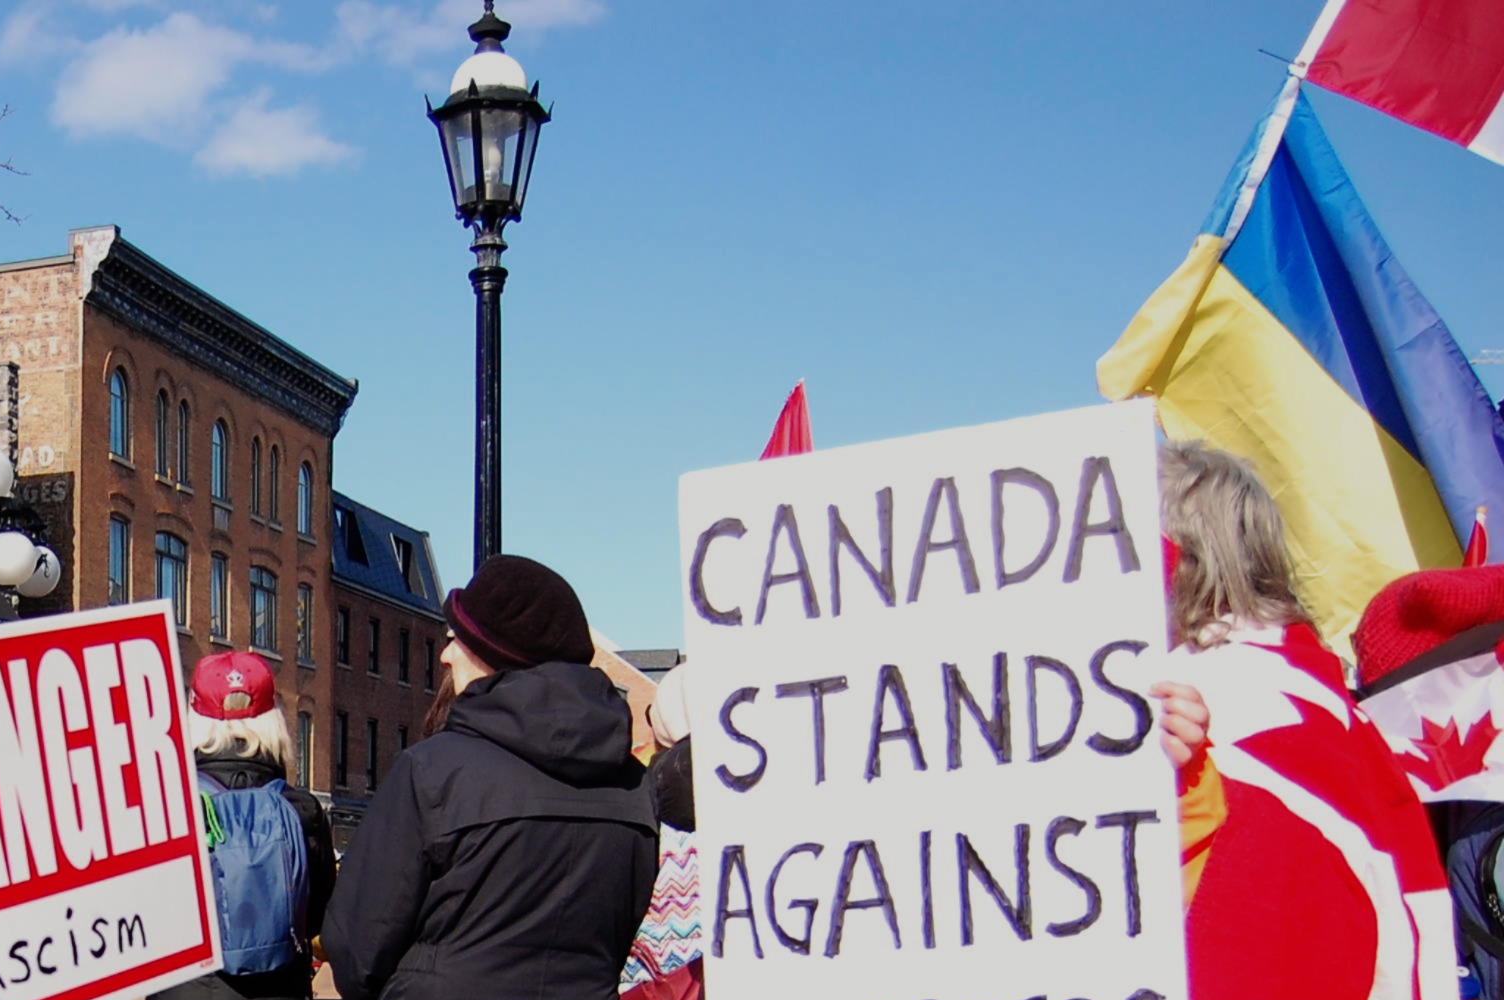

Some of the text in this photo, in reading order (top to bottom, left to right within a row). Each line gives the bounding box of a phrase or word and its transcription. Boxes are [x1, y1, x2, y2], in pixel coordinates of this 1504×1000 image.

[689, 456, 1141, 627] CANADA
[714, 640, 1155, 793] STANDS
[712, 810, 1160, 959] AGAINST
